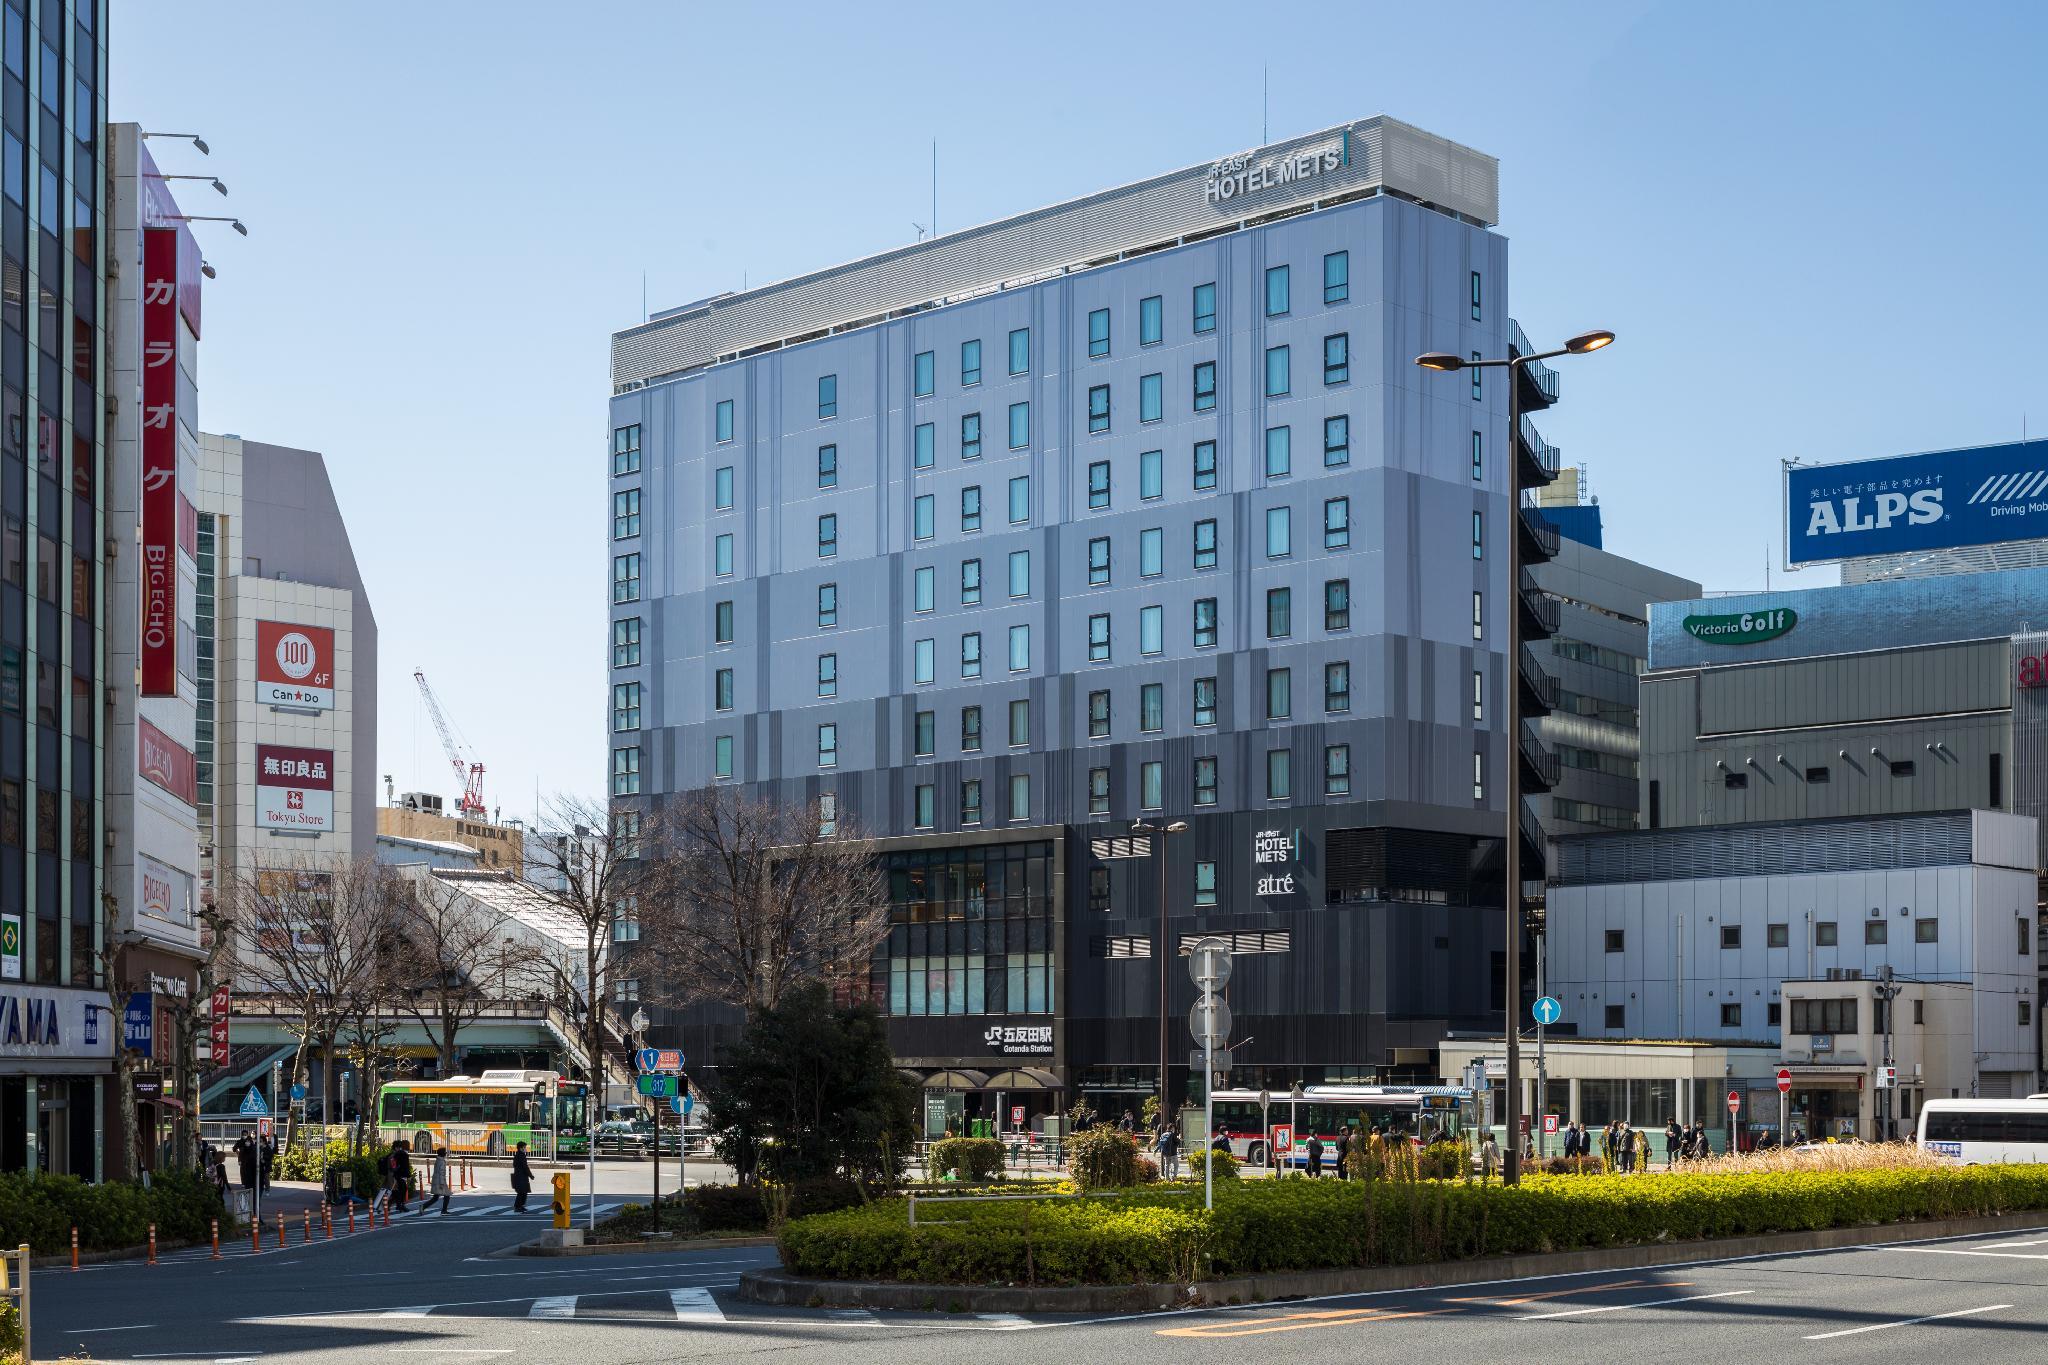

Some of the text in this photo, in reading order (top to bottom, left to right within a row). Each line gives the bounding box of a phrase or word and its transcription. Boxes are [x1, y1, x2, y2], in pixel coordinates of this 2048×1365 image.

[1205, 150, 1340, 202] HOTEL METS
[1208, 157, 1249, 179] JR-EAST
[144, 279, 175, 491] カラオケ
[1810, 473, 1944, 499] 美しい電子部品を究めます
[1806, 487, 1944, 536] ALPS
[1991, 504, 2026, 517] Driving
[1690, 610, 1785, 635] Victoria Golf
[284, 641, 308, 665] 100
[314, 673, 330, 685] 6F
[264, 756, 327, 779] 無印良品
[267, 810, 324, 826] Tokyu Store
[1255, 837, 1294, 851] HOTEL
[1255, 849, 1288, 863] METS
[1256, 873, 1295, 895] atré
[214, 993, 227, 1059] カラオケ
[1003, 1026, 1053, 1043] 五反田駅
[648, 1052, 654, 1065] 1
[1003, 1045, 1053, 1053] Gotanda Station
[652, 1079, 664, 1092] 317
